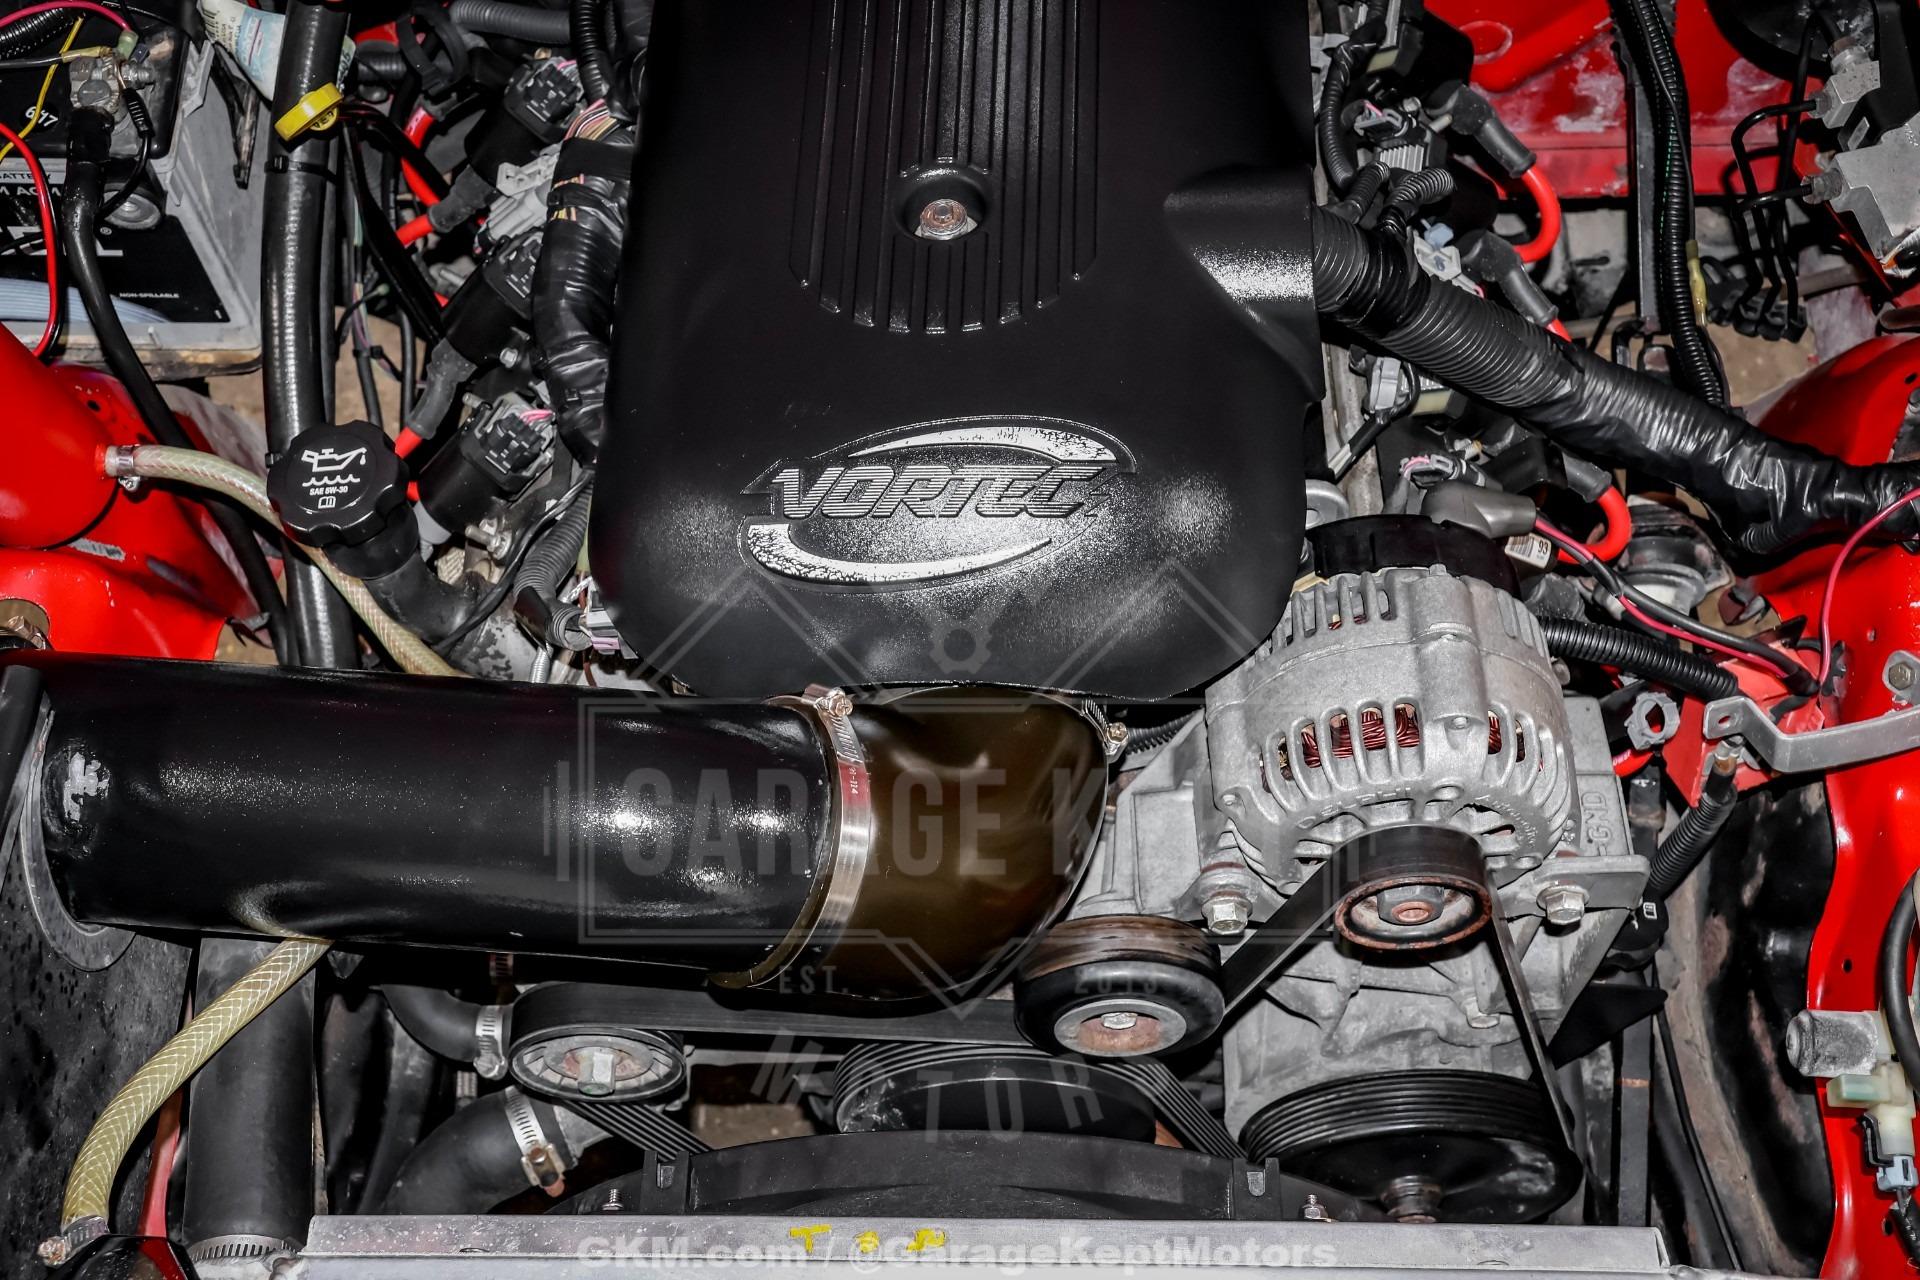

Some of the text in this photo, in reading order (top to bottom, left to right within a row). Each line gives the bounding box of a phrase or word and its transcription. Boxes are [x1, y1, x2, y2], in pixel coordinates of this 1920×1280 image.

[309, 485, 348, 496] SAE 5W-30
[772, 464, 1104, 519] VORTEC
[1537, 540, 1549, 555] 93
